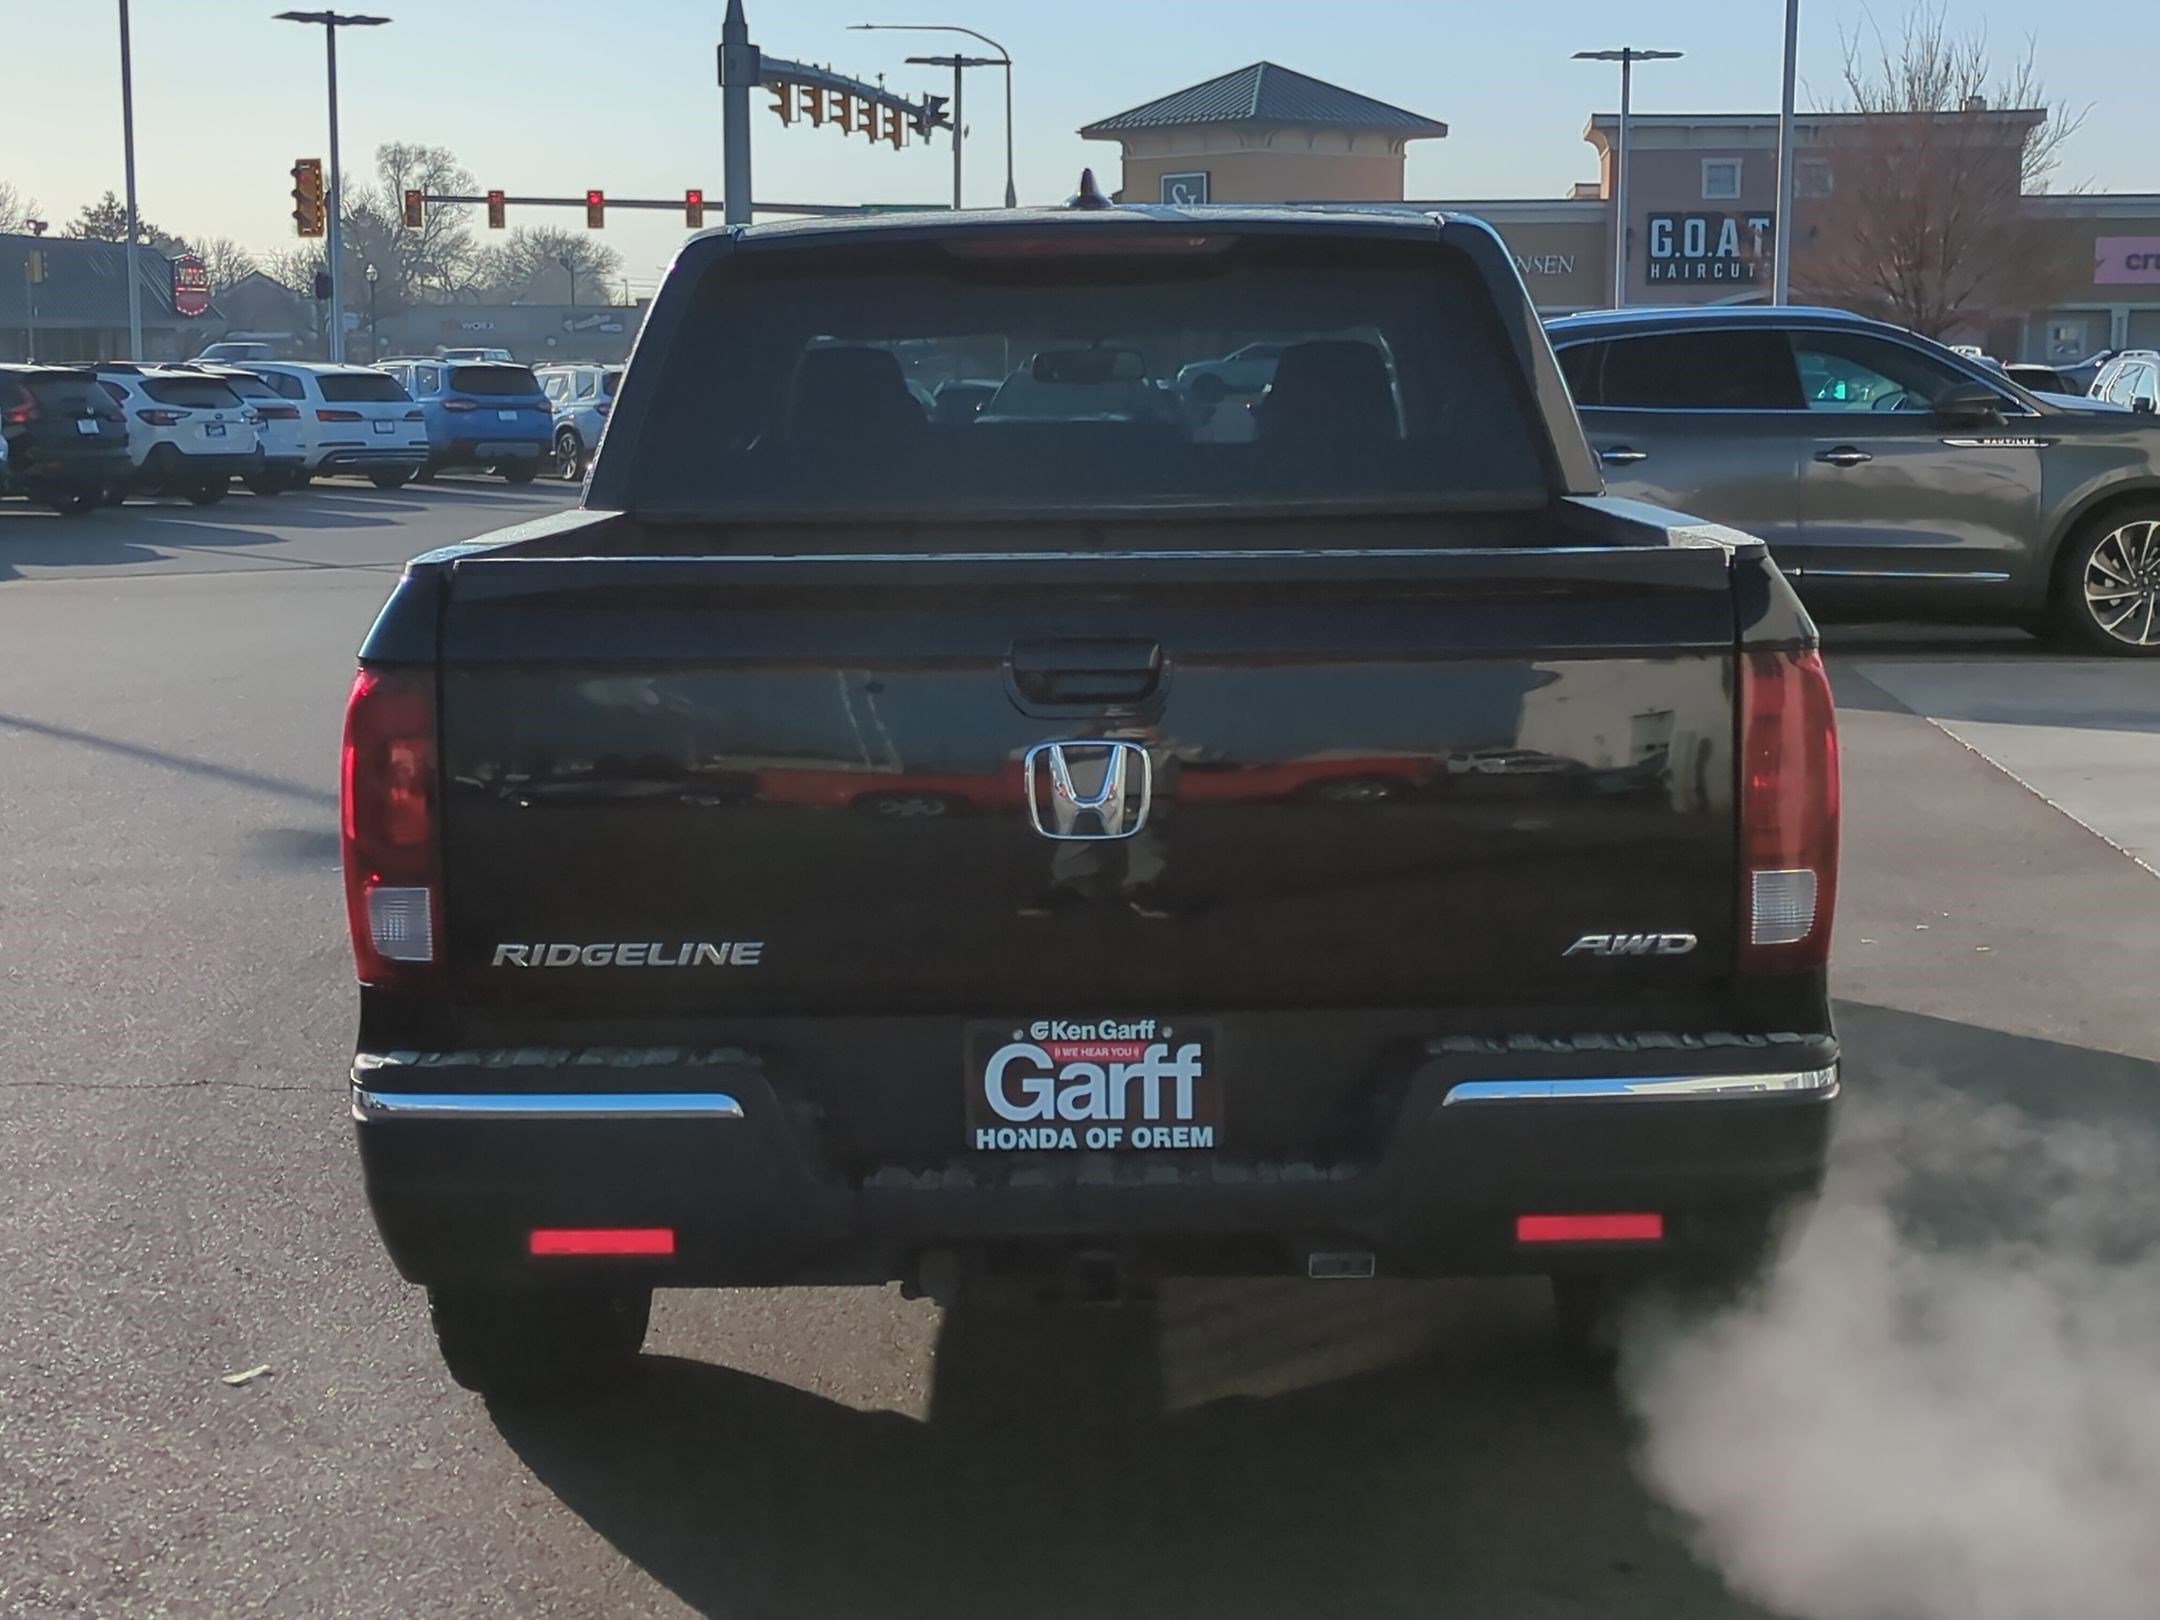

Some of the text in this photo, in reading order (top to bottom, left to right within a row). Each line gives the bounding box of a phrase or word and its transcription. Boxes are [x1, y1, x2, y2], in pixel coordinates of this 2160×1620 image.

[1513, 255, 1575, 274] NSEN
[492, 942, 764, 967] RIDGELINE
[1562, 934, 1698, 956] AWD
[1052, 1020, 1155, 1040] Ken Garff
[1062, 1047, 1132, 1057] WE HEAR YOU
[984, 1043, 1202, 1121] Garff
[976, 1126, 1214, 1149] HONDA OF OREM
